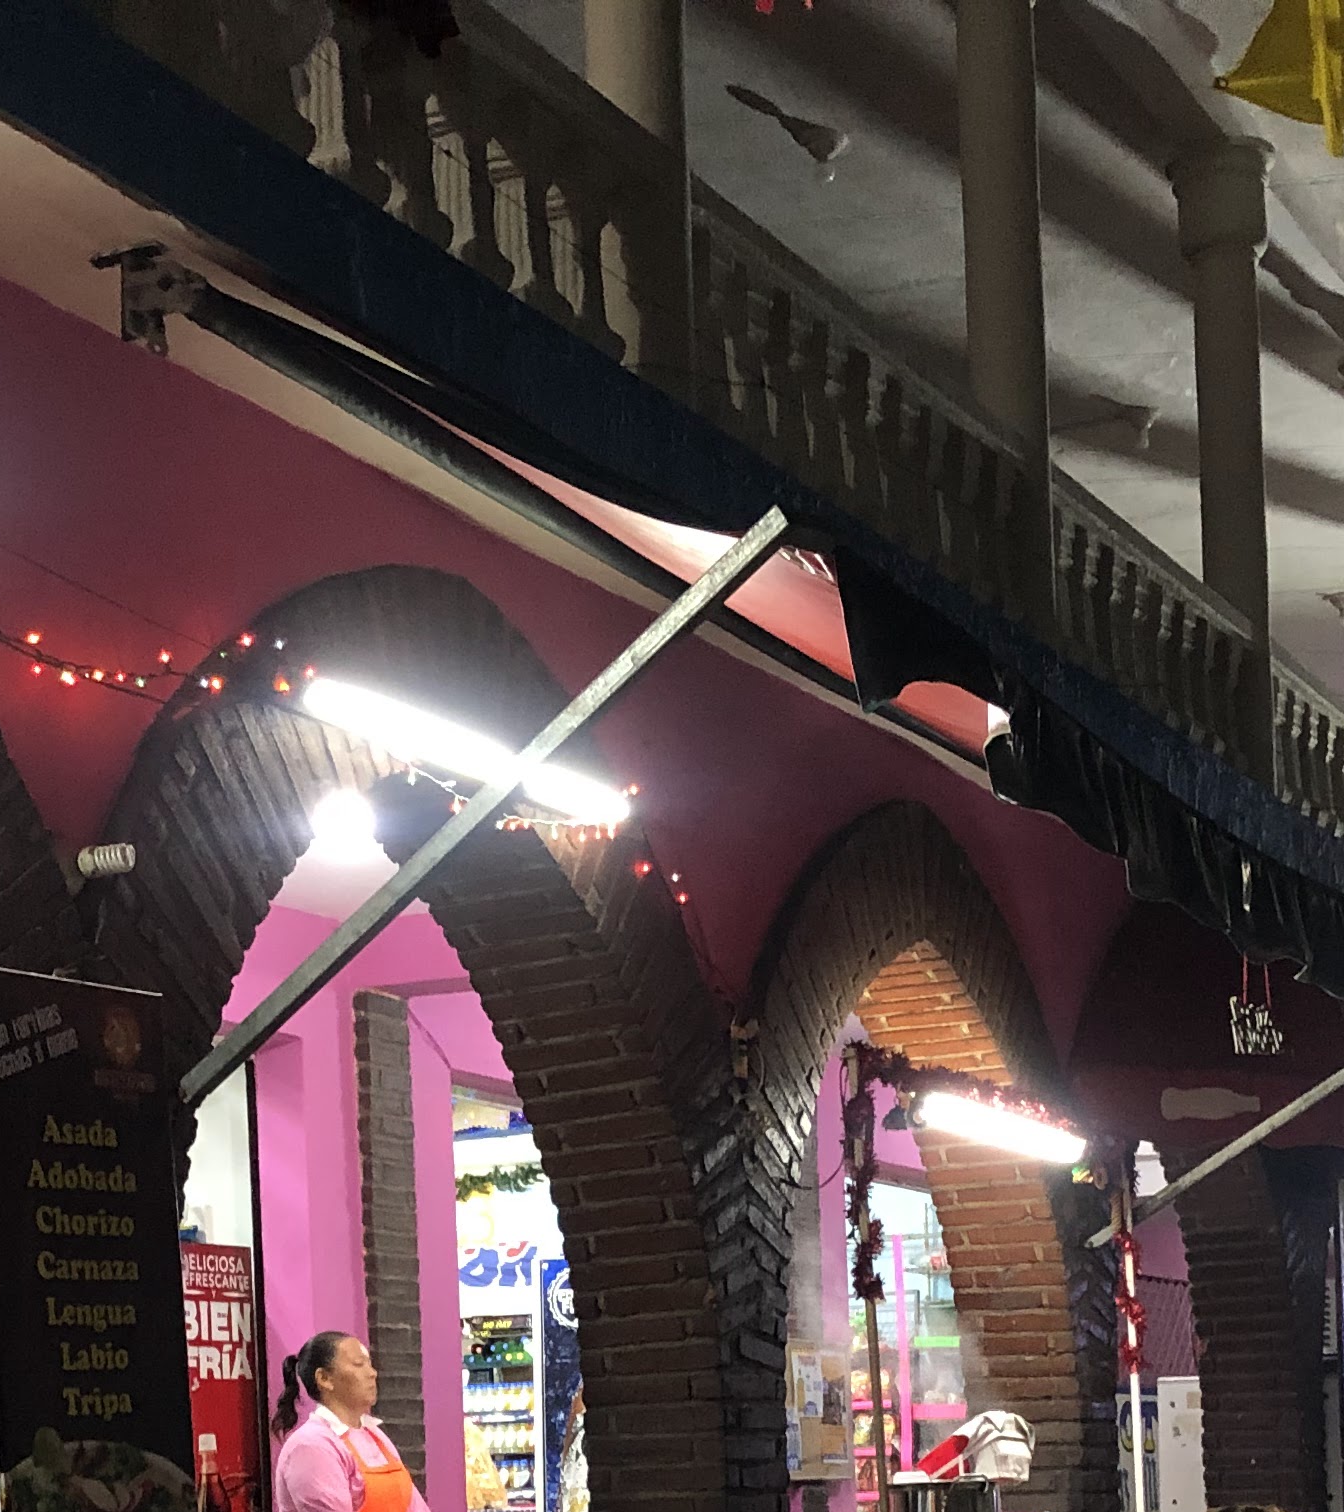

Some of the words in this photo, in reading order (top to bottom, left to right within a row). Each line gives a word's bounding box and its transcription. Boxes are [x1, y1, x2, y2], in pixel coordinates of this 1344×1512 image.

[42, 1114, 118, 1149] Asada
[27, 1158, 137, 1193] Adobada
[34, 1204, 136, 1238] Chorizo
[36, 1249, 140, 1282] Carnaza
[45, 1296, 137, 1334] Lengua
[184, 1298, 252, 1343] BIEN
[59, 1341, 129, 1372] Labio
[62, 1386, 134, 1422] Tripa
